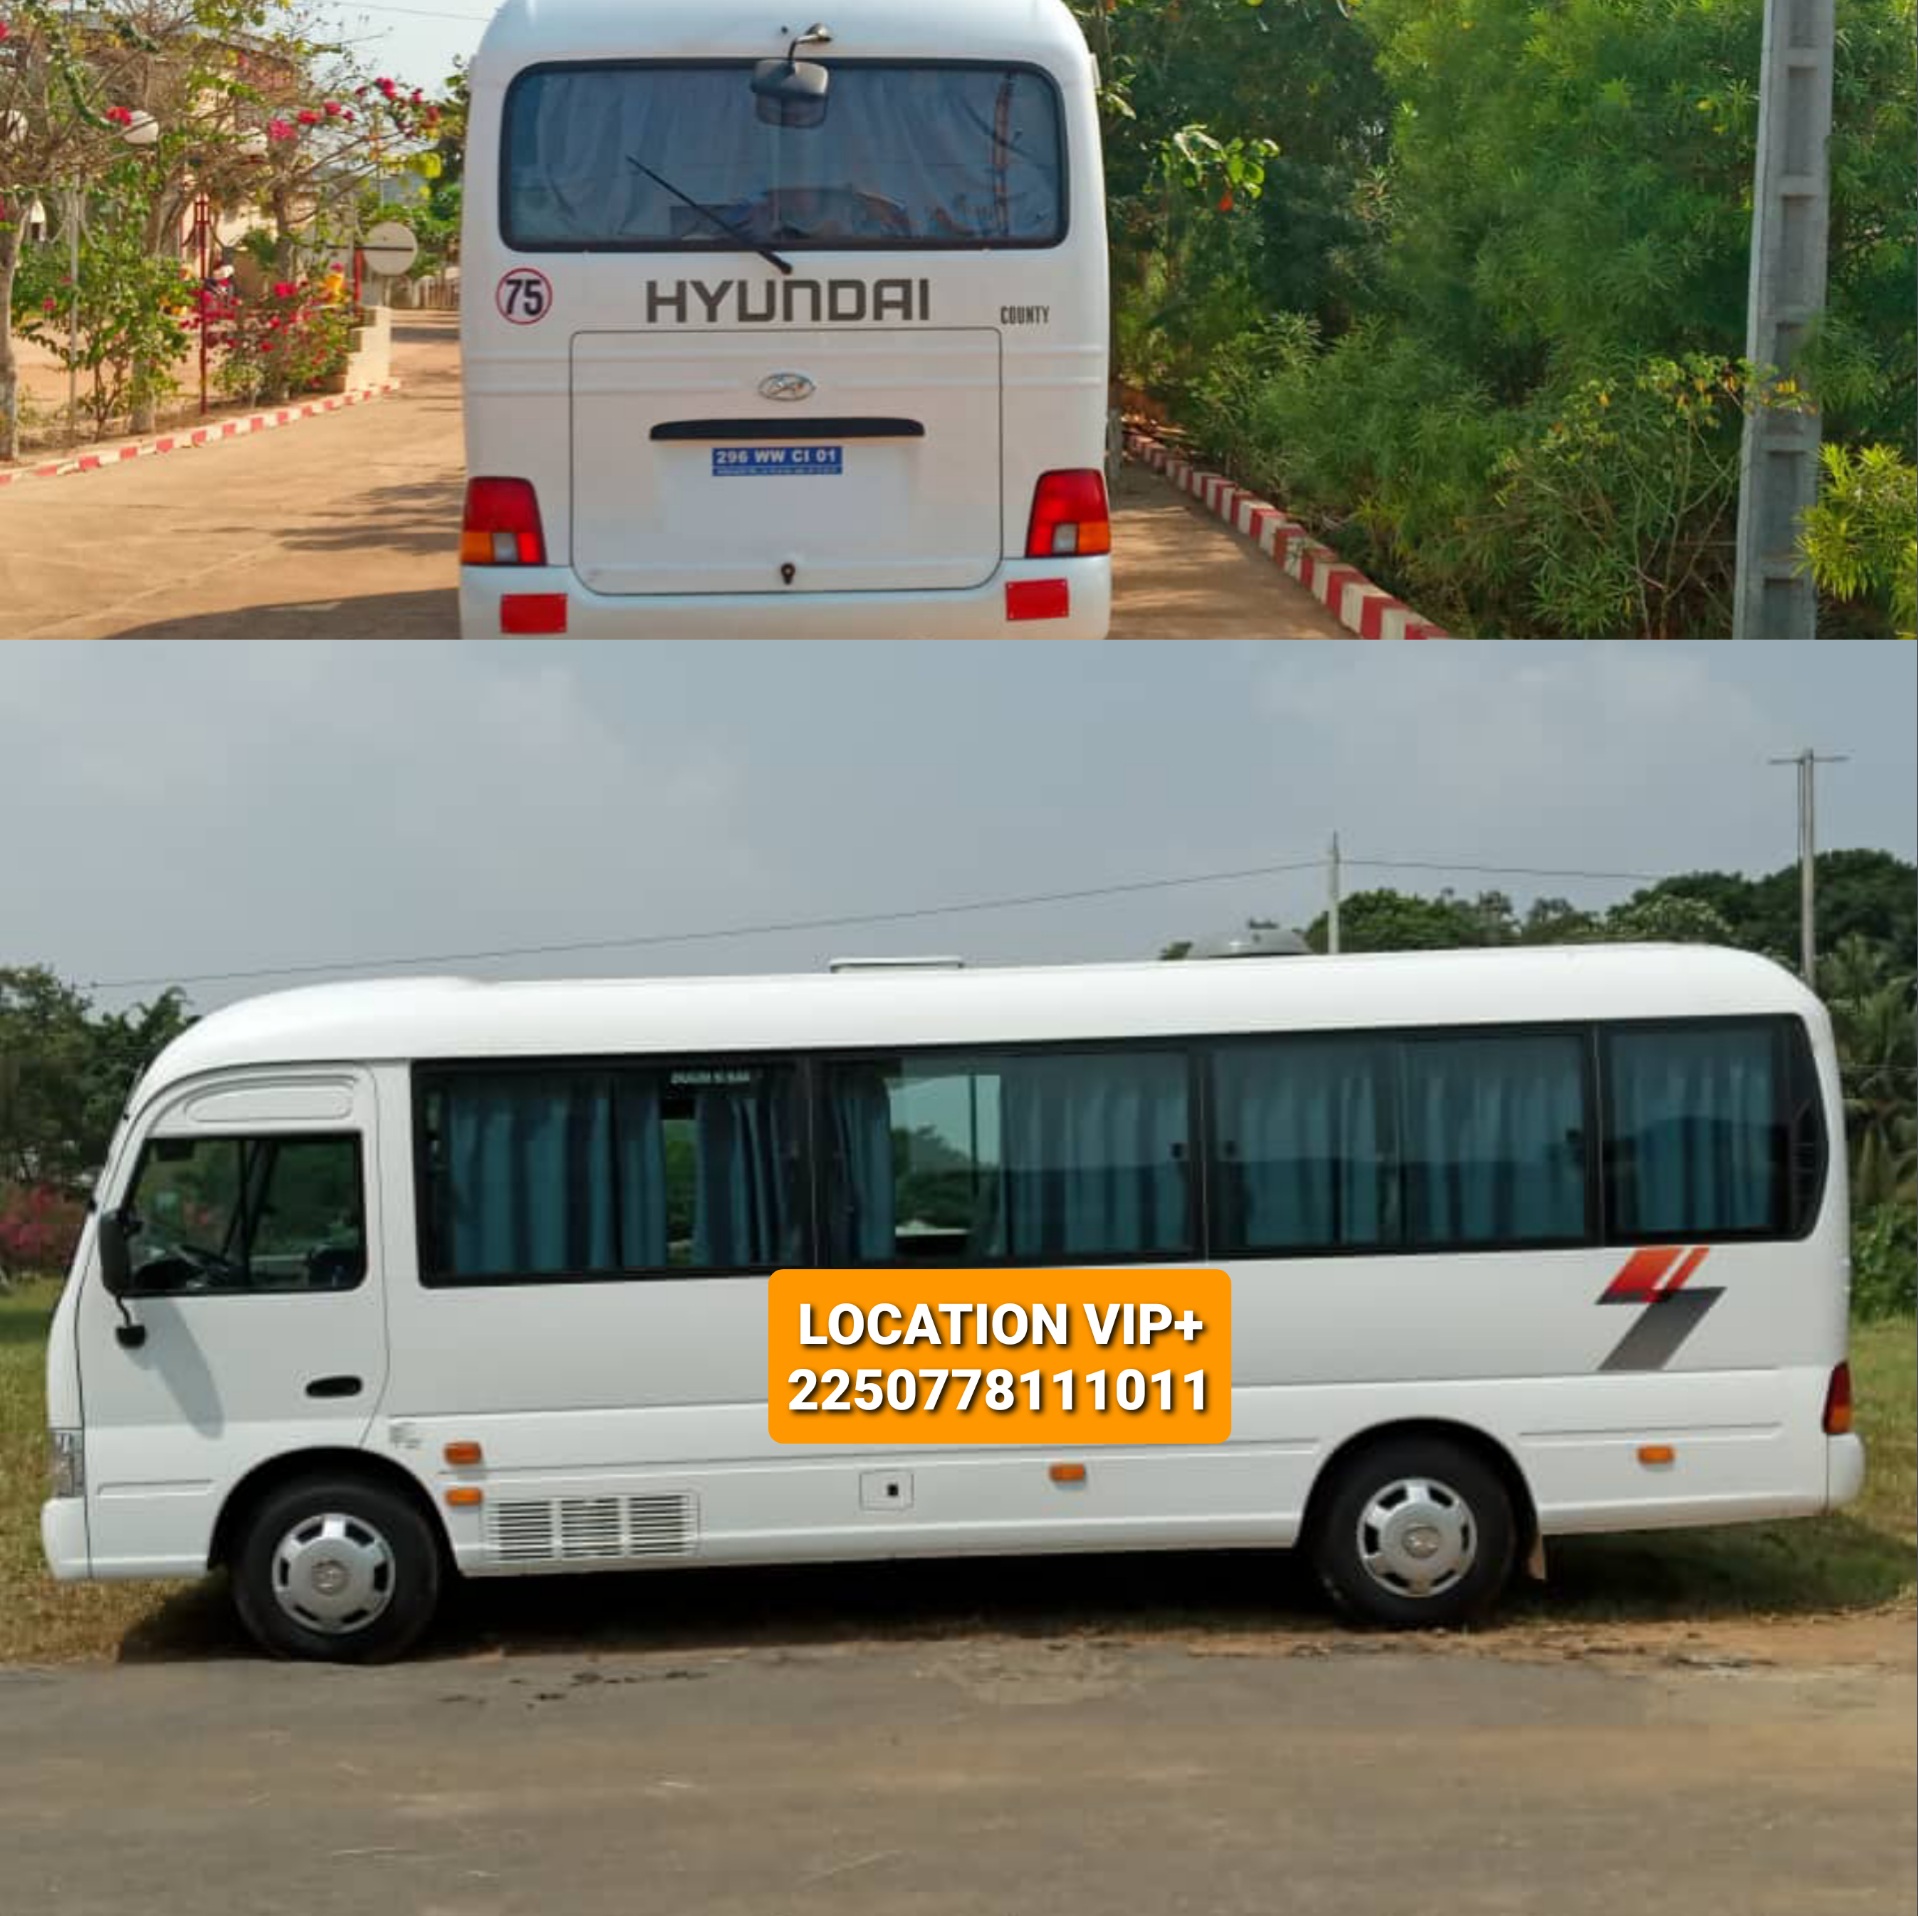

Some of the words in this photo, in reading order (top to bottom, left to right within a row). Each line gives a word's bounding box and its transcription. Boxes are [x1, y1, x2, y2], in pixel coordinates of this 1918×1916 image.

[503, 278, 545, 316] 75
[645, 277, 930, 324] HYUNDAI
[1000, 305, 1050, 325] COUNTY
[716, 449, 748, 464] 296
[754, 449, 785, 463] WW
[791, 449, 810, 462] CI
[815, 448, 836, 462] 01
